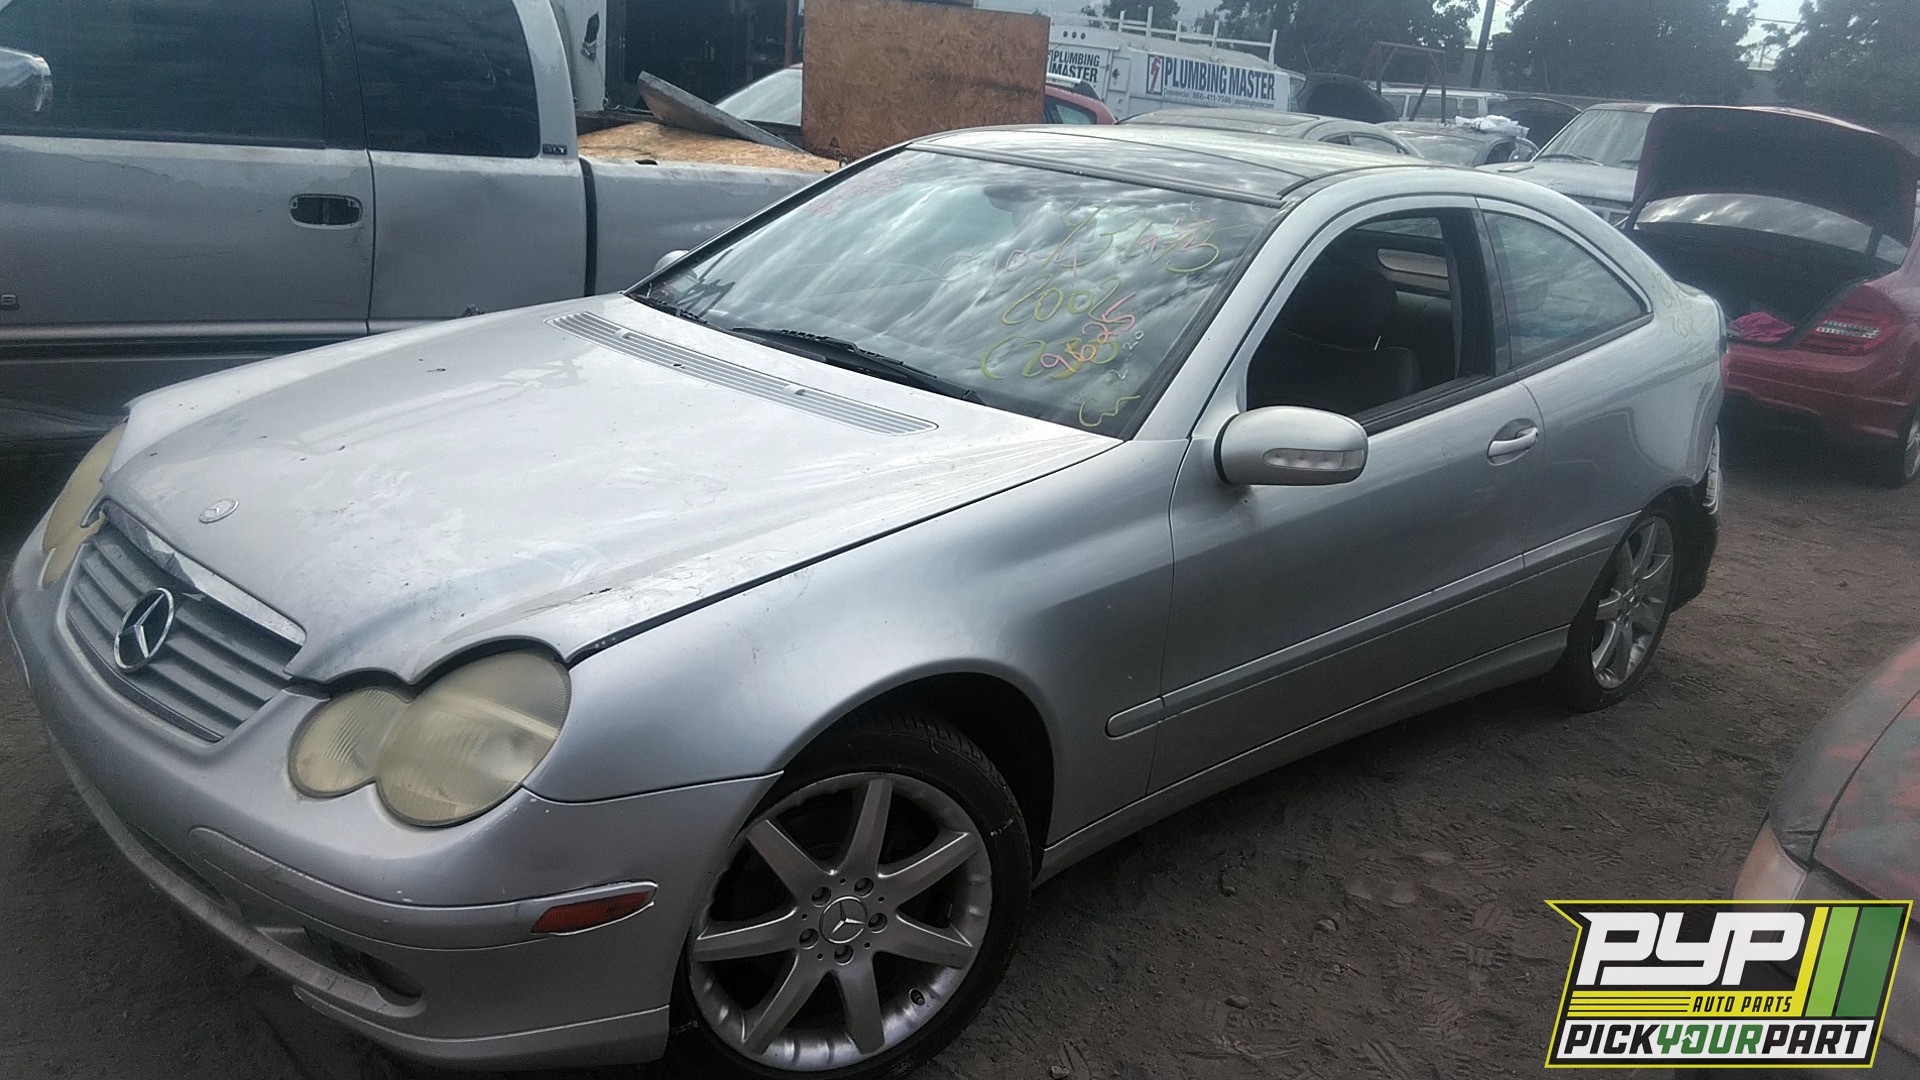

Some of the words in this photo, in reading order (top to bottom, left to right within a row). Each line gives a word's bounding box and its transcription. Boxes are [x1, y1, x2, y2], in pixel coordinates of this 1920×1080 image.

[1053, 50, 1100, 67] PLUMBING
[1051, 63, 1098, 83] MASTER
[1164, 56, 1227, 94] PLUMBING
[1228, 66, 1275, 100] MASTER
